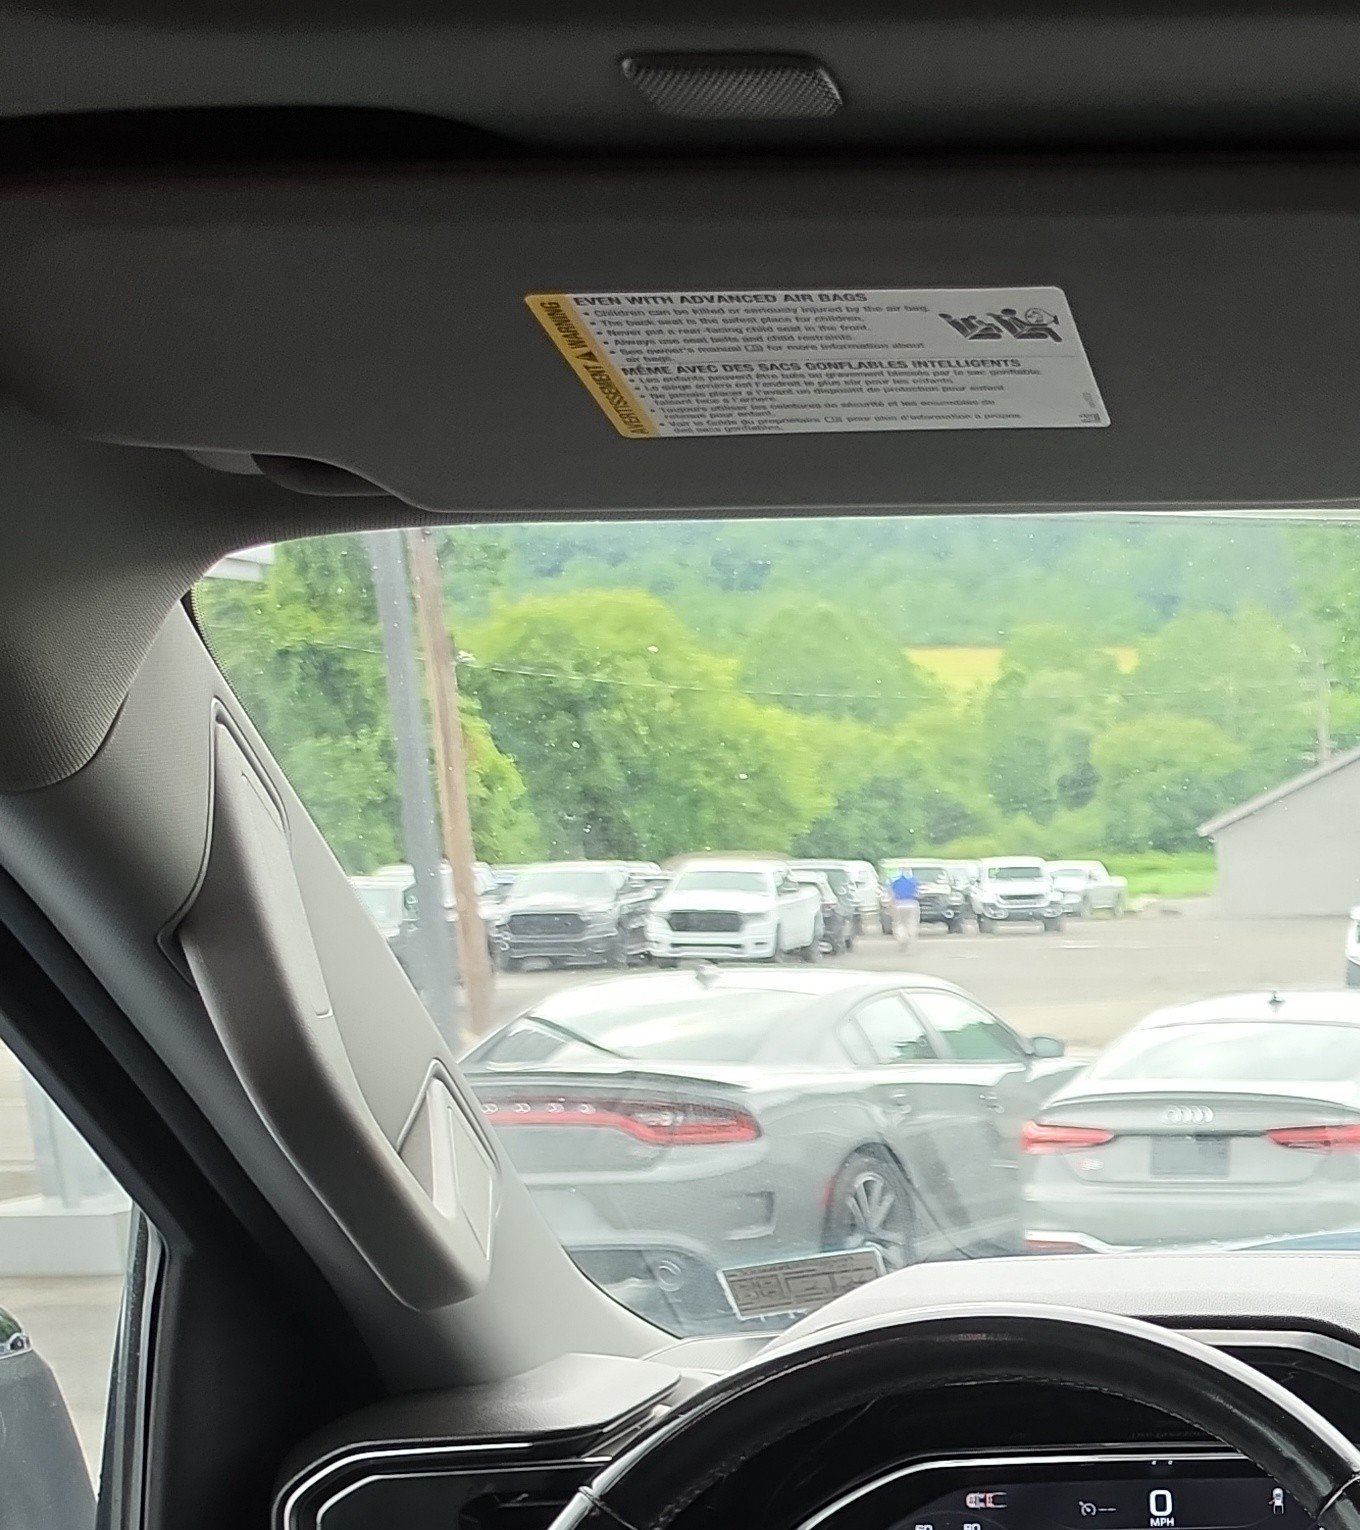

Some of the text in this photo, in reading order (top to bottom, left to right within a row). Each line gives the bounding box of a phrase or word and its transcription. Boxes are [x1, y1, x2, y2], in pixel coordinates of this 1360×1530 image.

[573, 293, 868, 306] EVEN WITH ADVANCED AIR BAGS
[540, 301, 588, 350] WARNING
[676, 364, 719, 374] AVEC
[723, 364, 754, 373] DES
[758, 362, 801, 372] SACS
[805, 360, 908, 371] GONFLABLES
[911, 358, 1021, 369] INTELLIGENTS
[584, 364, 649, 435] AVERTISSEMENT
[1149, 1489, 1173, 1517] 0
[1150, 1517, 1174, 1527] MPH
